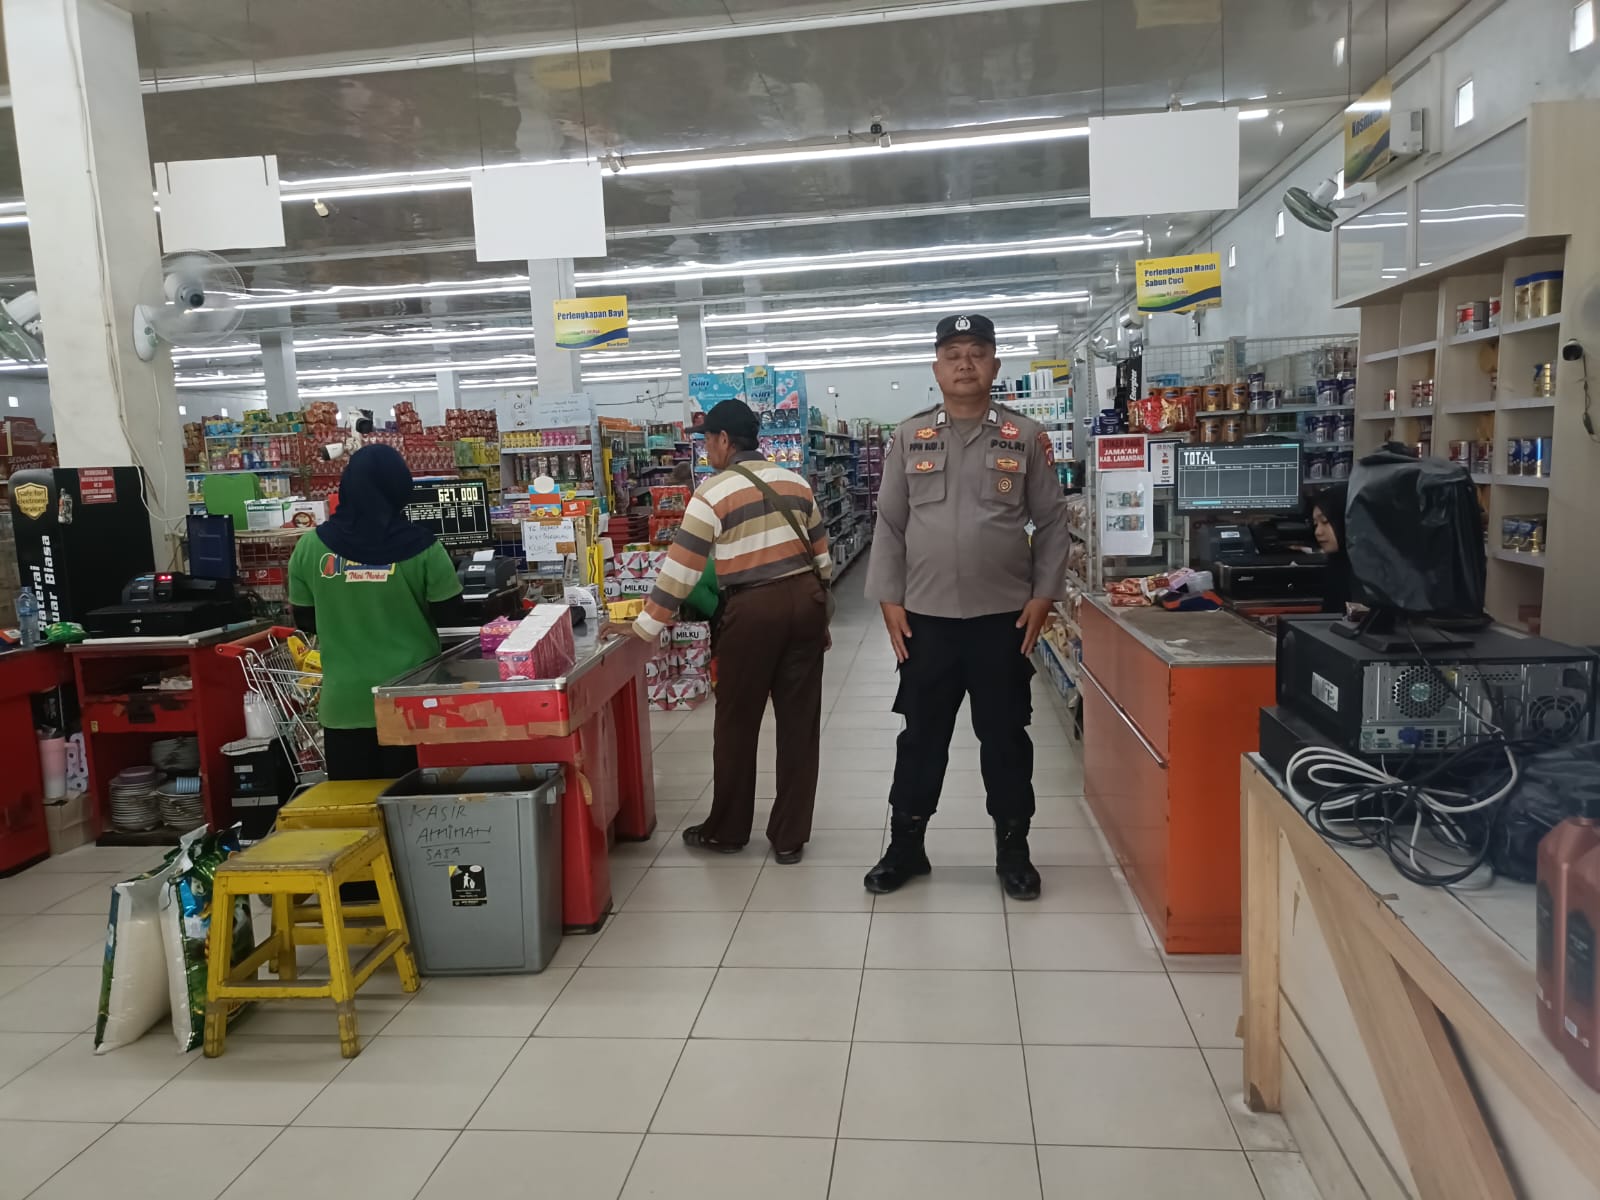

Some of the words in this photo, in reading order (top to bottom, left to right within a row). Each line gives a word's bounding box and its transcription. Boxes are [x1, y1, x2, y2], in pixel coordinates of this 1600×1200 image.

[1144, 265, 1193, 277] Perlengkapan
[1194, 263, 1216, 272] Mandi
[1145, 279, 1167, 288] Sabun
[1168, 277, 1184, 285] Cuci
[557, 310, 607, 321] Perlengkapan
[608, 308, 624, 318] Bayi
[990, 439, 1025, 452] POLRI
[1104, 447, 1139, 456] JAMA'AH
[1099, 455, 1112, 463] KAB.
[1183, 451, 1216, 465] TOTAL
[438, 487, 478, 503] 627.000
[41, 535, 56, 585] Biasa
[624, 584, 649, 593] MILKU
[49, 591, 60, 622] uar
[676, 630, 700, 639] MILKU
[408, 804, 469, 827] KASIR
